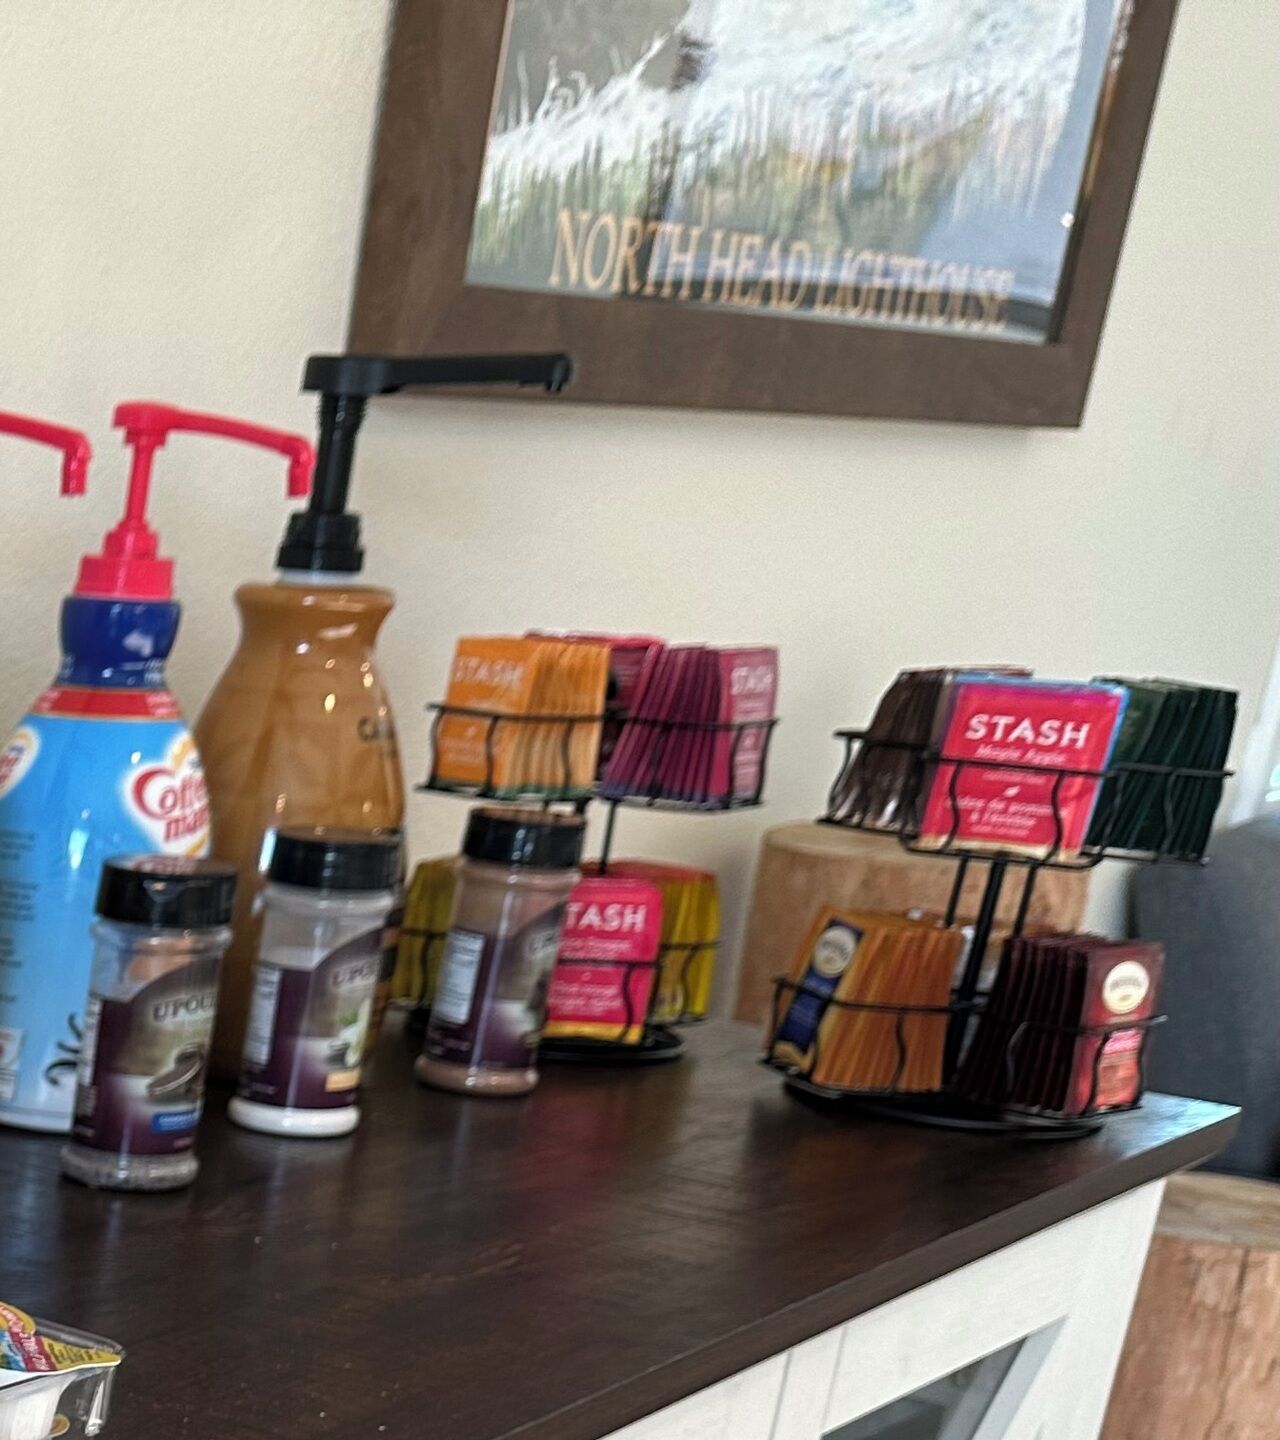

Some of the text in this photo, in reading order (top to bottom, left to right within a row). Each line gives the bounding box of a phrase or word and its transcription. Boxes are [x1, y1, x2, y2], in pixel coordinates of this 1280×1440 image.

[549, 206, 1017, 331] NORTH HEAD LIGHTHOUSE
[964, 713, 1091, 751] STASH
[566, 902, 648, 933] TASH
